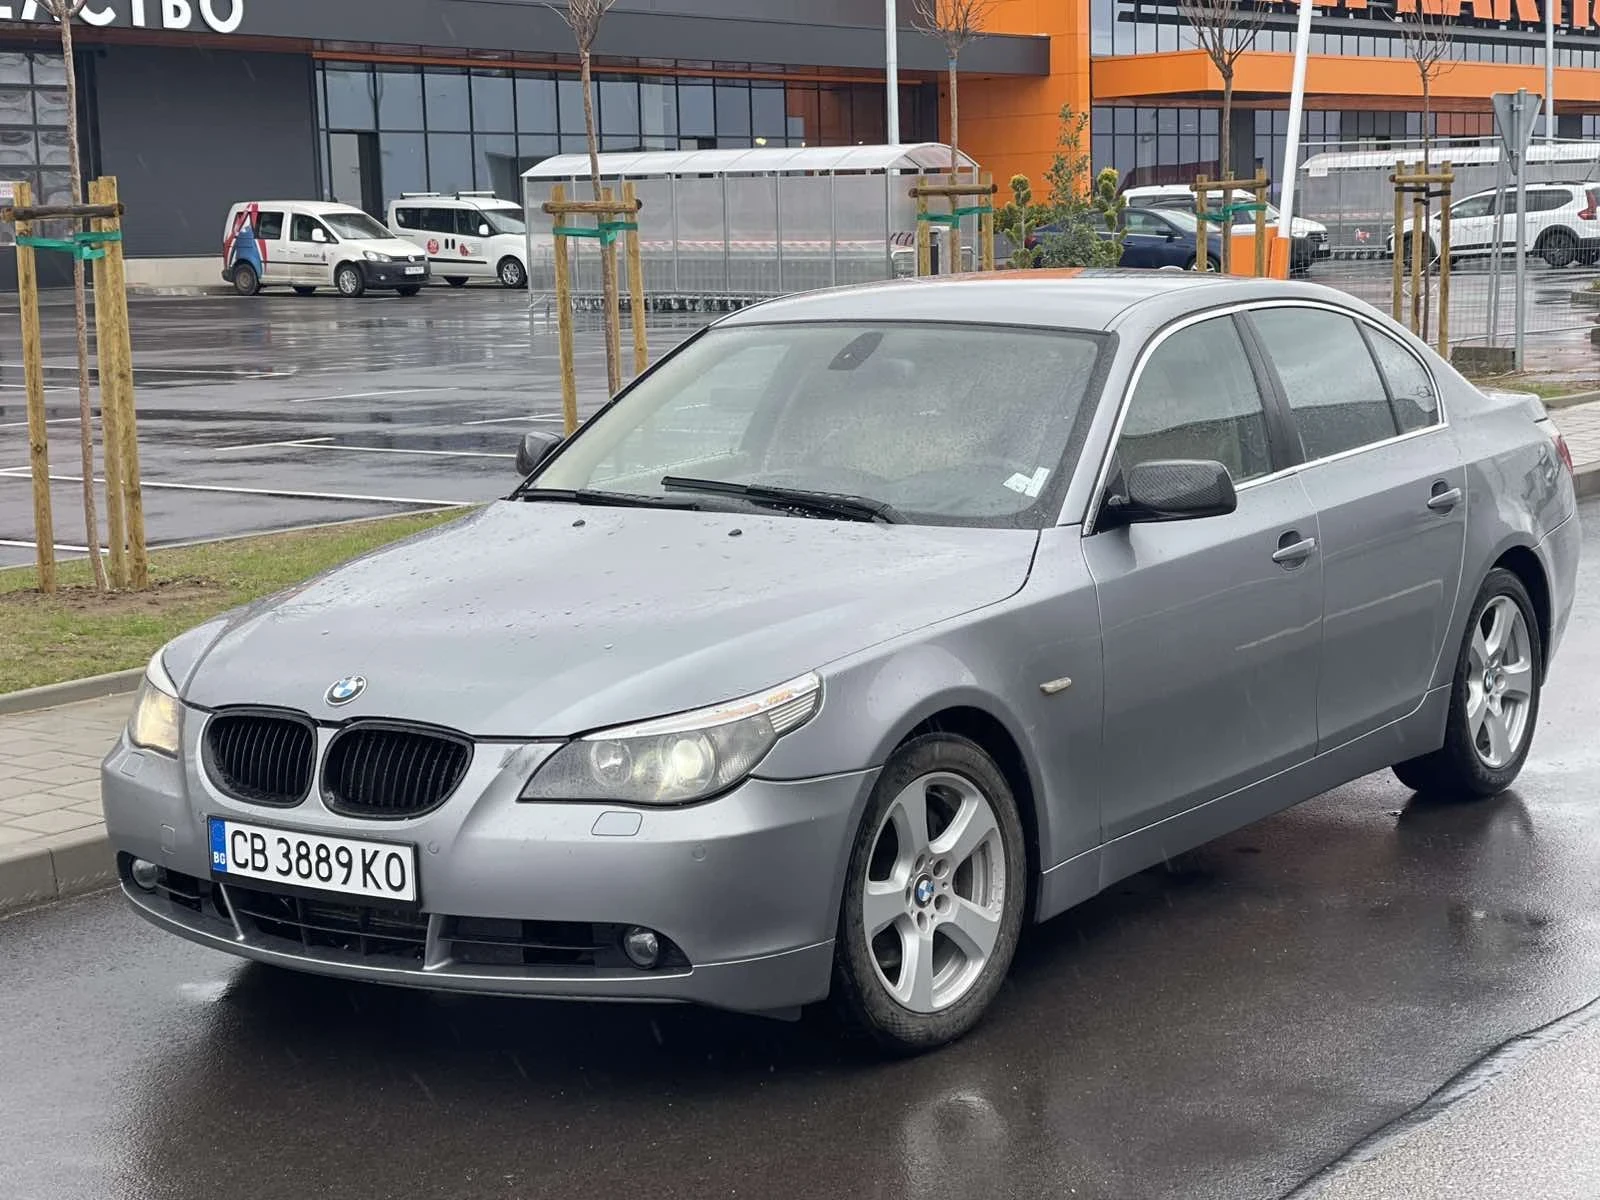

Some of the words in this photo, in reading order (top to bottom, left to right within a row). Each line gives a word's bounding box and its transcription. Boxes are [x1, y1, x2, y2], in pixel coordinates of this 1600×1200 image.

[213, 851, 226, 865] BG
[231, 830, 269, 872] CB
[276, 838, 353, 885] 3889
[361, 848, 406, 892] KO
